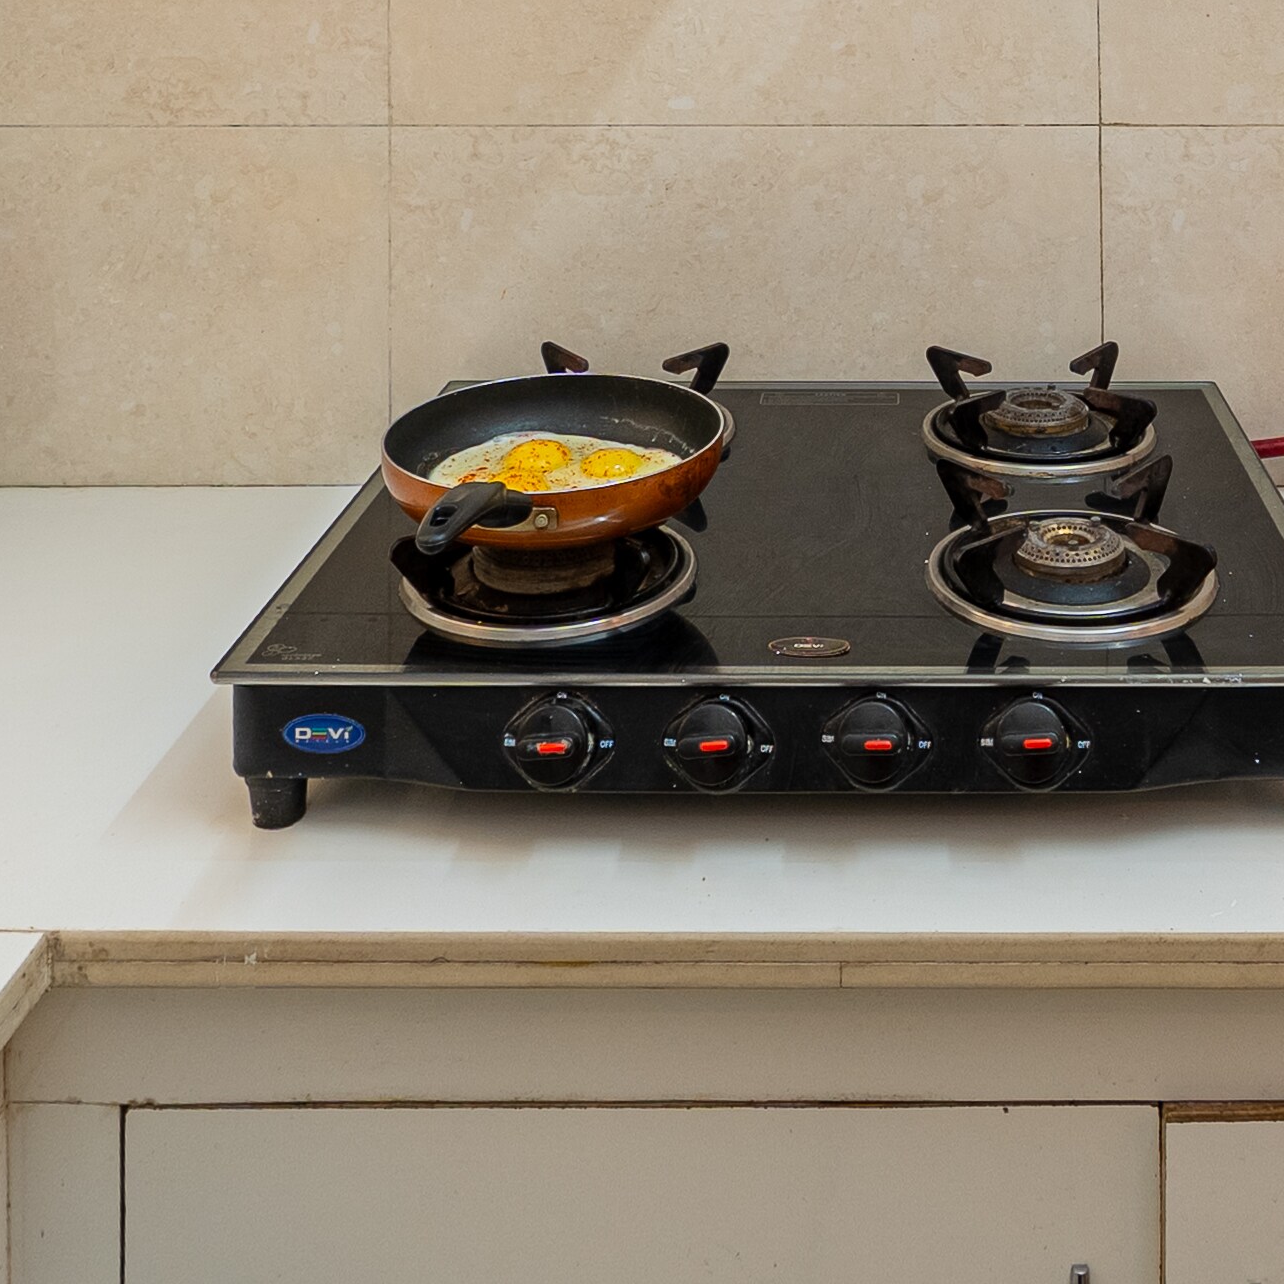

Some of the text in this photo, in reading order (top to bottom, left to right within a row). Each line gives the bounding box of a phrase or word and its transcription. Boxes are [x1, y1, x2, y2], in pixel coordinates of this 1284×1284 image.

[599, 740, 614, 749] OFF
[759, 744, 774, 753] OFF
[918, 740, 932, 749] OFF
[1077, 740, 1091, 749] OFF
